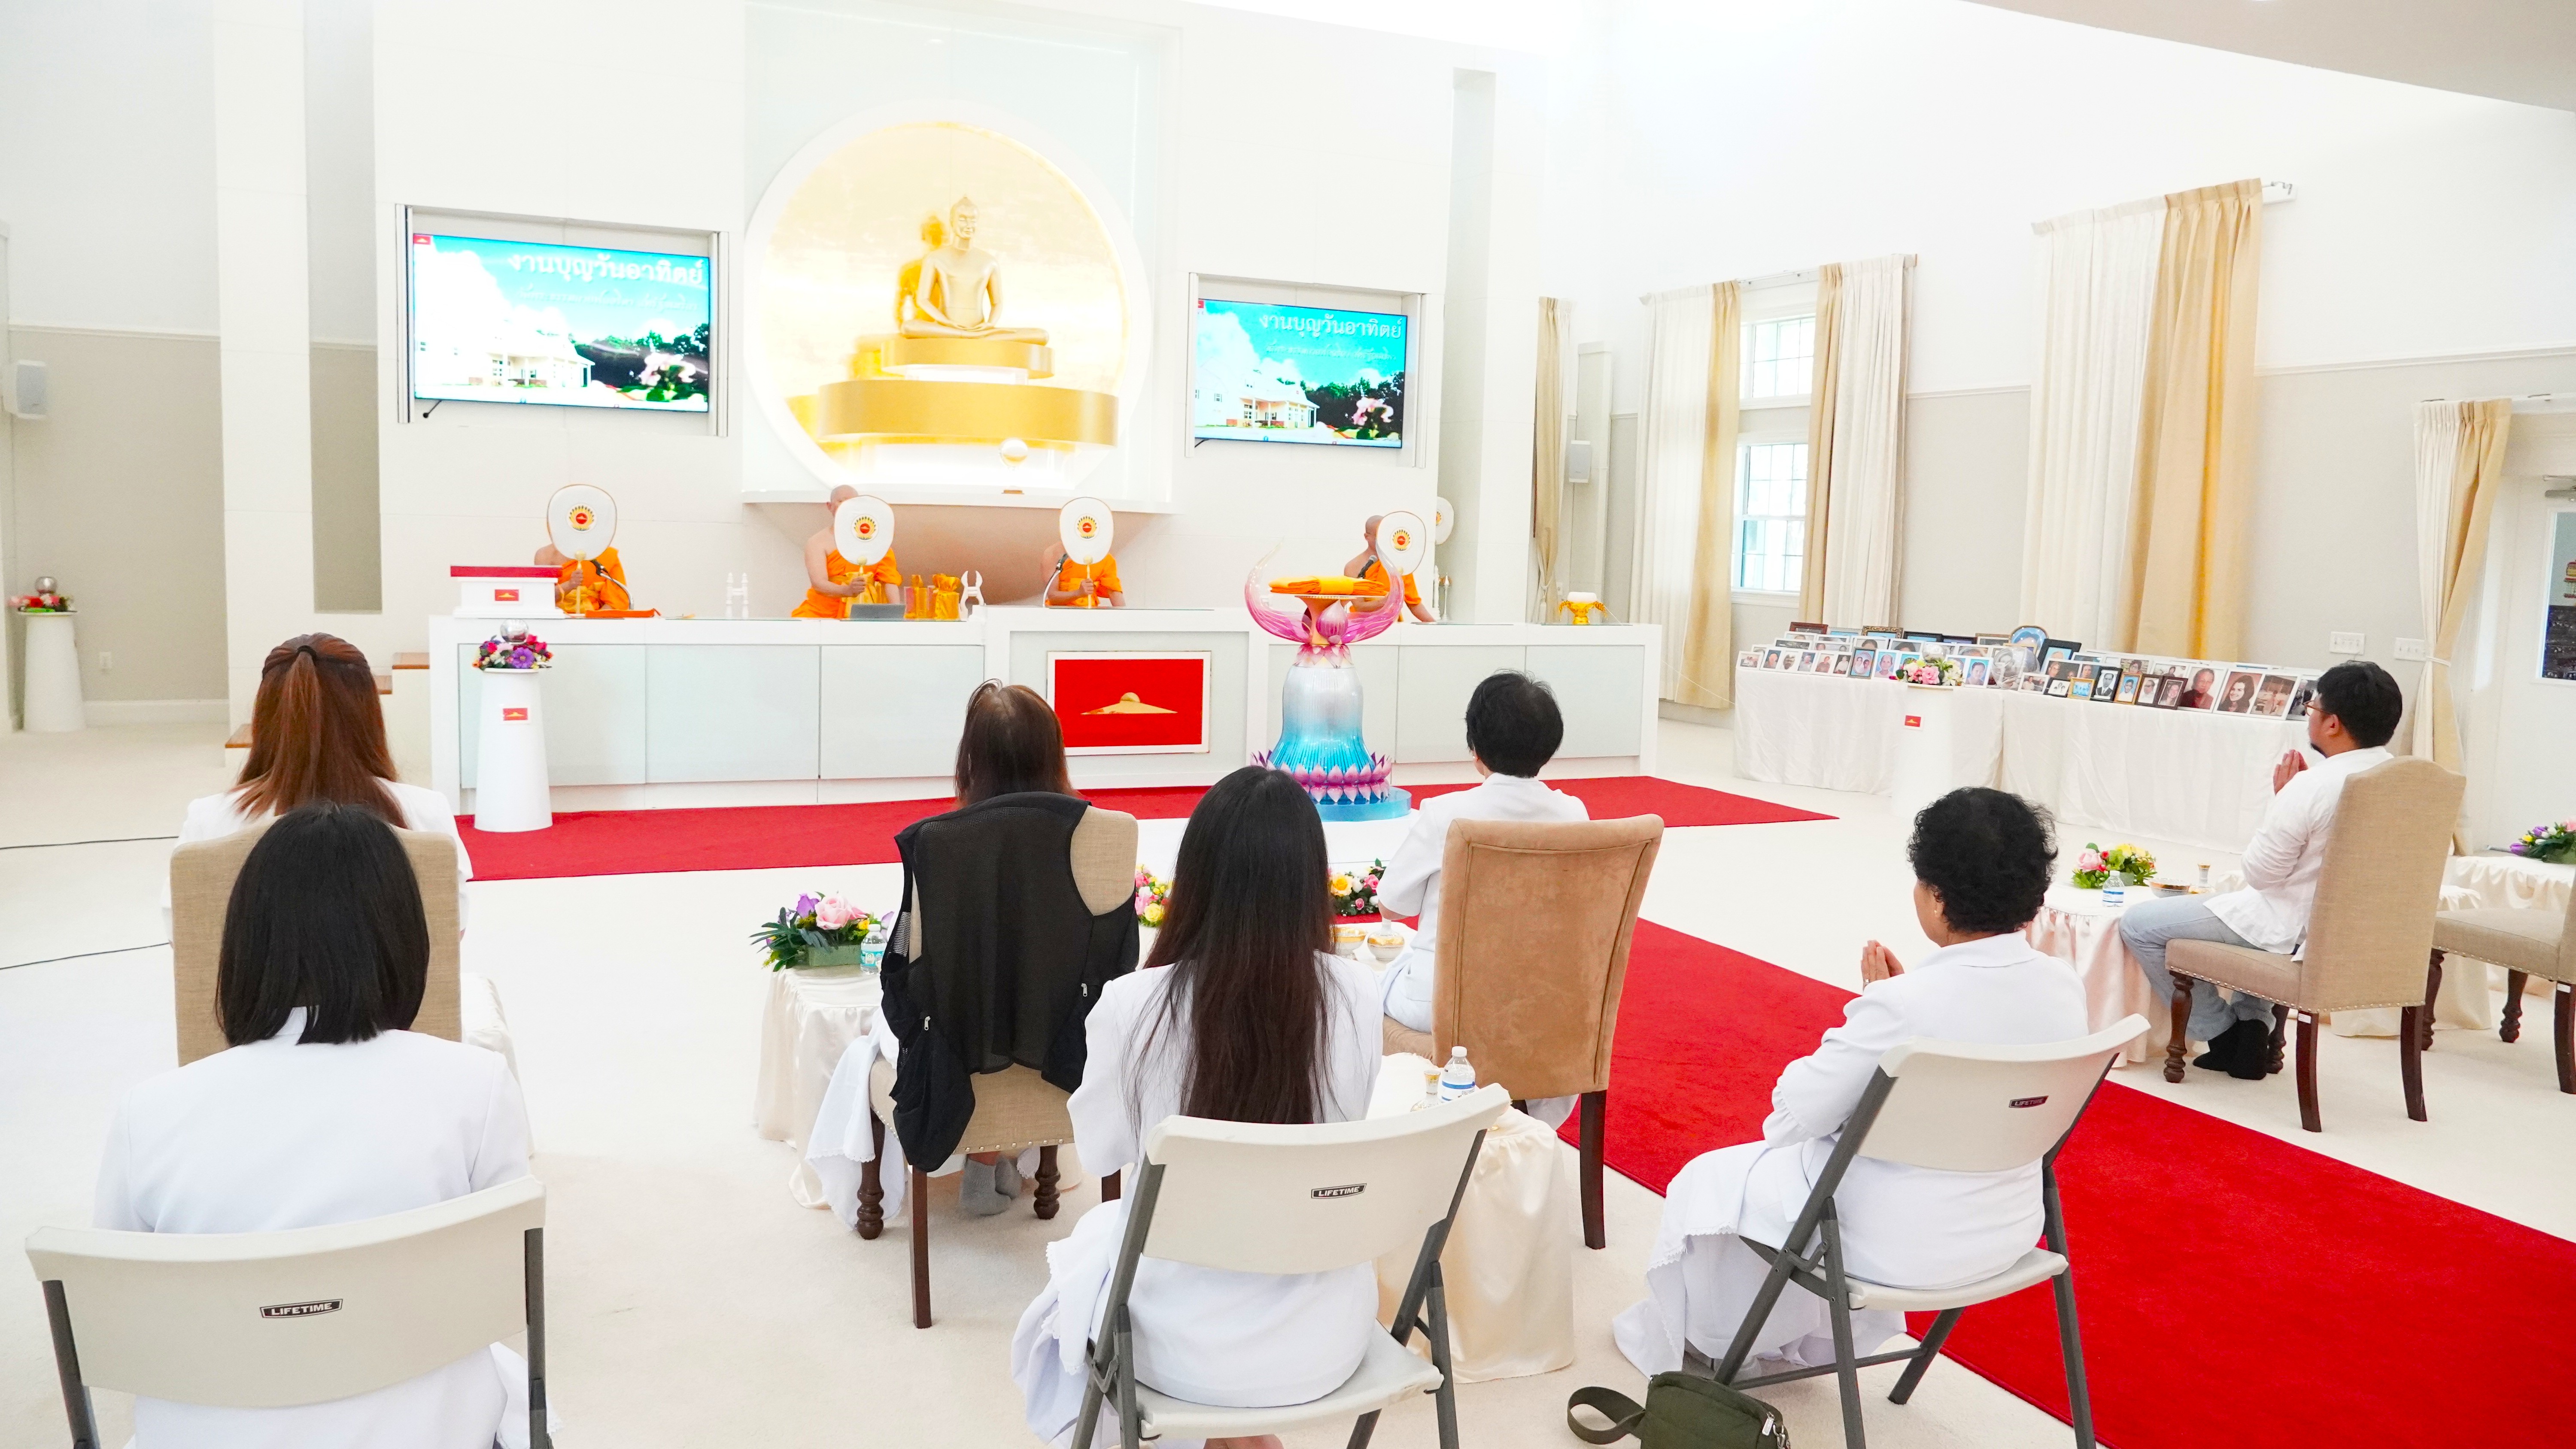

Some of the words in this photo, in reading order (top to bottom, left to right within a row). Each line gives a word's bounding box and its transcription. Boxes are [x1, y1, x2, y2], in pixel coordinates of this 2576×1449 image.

[508, 253, 704, 285] งานบุญวันอาทิตย์
[1259, 313, 1403, 339] งานบุญวันอาทิตย์
[1318, 1186, 1360, 1196] LIFETIME
[271, 1302, 332, 1316] LIFETIME
